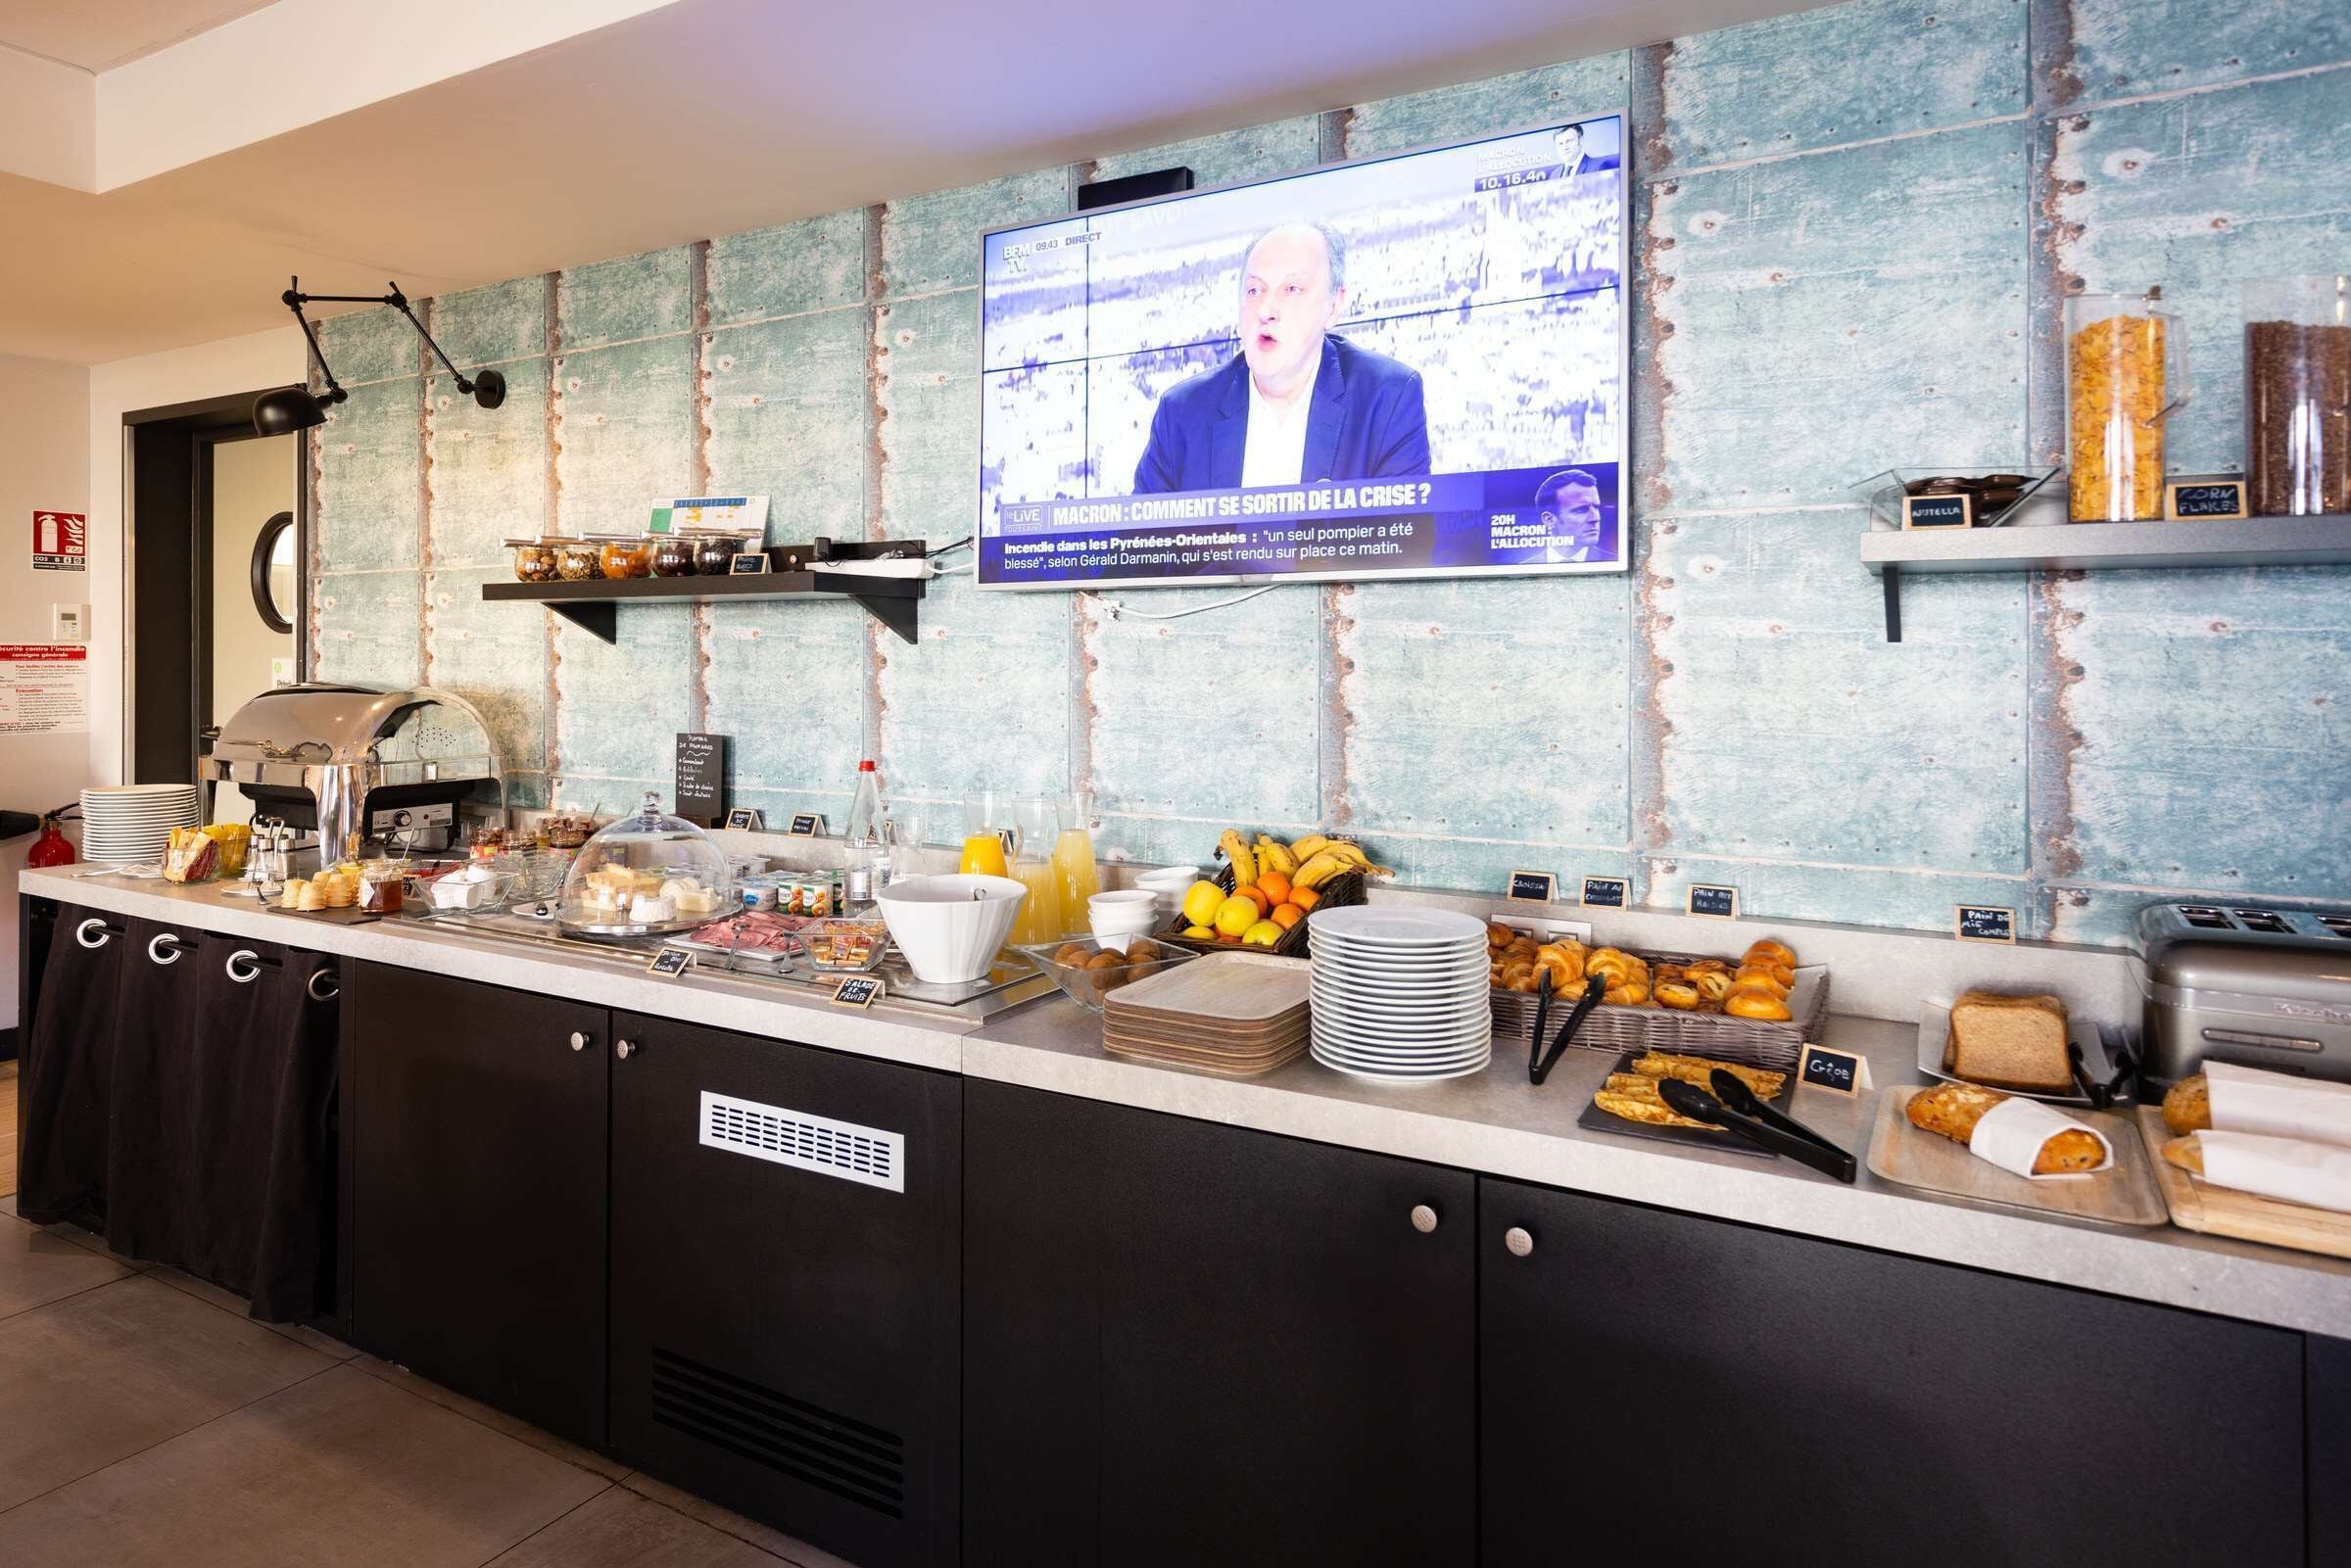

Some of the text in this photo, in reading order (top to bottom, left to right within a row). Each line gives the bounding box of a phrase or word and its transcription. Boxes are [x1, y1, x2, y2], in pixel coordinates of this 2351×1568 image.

[1066, 232, 1101, 246] DIRECT
[2179, 488, 2235, 499] CORN
[1054, 504, 1121, 526] MACRON
[1131, 498, 1216, 522] COMMENT
[1219, 496, 1239, 516] SE
[1242, 492, 1305, 513] SORTIR
[1309, 490, 1333, 510] DE
[1334, 488, 1357, 509] LA
[1360, 484, 1416, 508] CRISE
[1418, 483, 1431, 504] ?
[2180, 500, 2239, 514] FLAKES
[1912, 507, 1960, 517] NUTELLA
[1491, 514, 1515, 526] 20H
[1005, 541, 1054, 554] Incendie
[1057, 540, 1086, 552] dans
[1089, 539, 1107, 550] les
[1110, 531, 1246, 552] Pyrénées-Orientales
[1288, 527, 1315, 541] seul
[1318, 525, 1372, 543] pompier
[1377, 527, 1386, 538] a
[1389, 522, 1413, 536] été
[1491, 536, 1574, 549] L'ALLOCUTION
[1048, 555, 1078, 568] selon
[1080, 553, 1118, 567] Gérald
[1121, 551, 1179, 565] Darmanin,
[1182, 549, 1200, 563] qui
[1203, 548, 1232, 561] s'est
[1236, 546, 1272, 559] rendu
[1276, 547, 1297, 558] sur
[1300, 544, 1335, 560] place
[1339, 545, 1355, 556] ce
[1359, 542, 1403, 555] matin.
[845, 979, 876, 989] SALADE
[839, 992, 866, 1001] FRUITS
